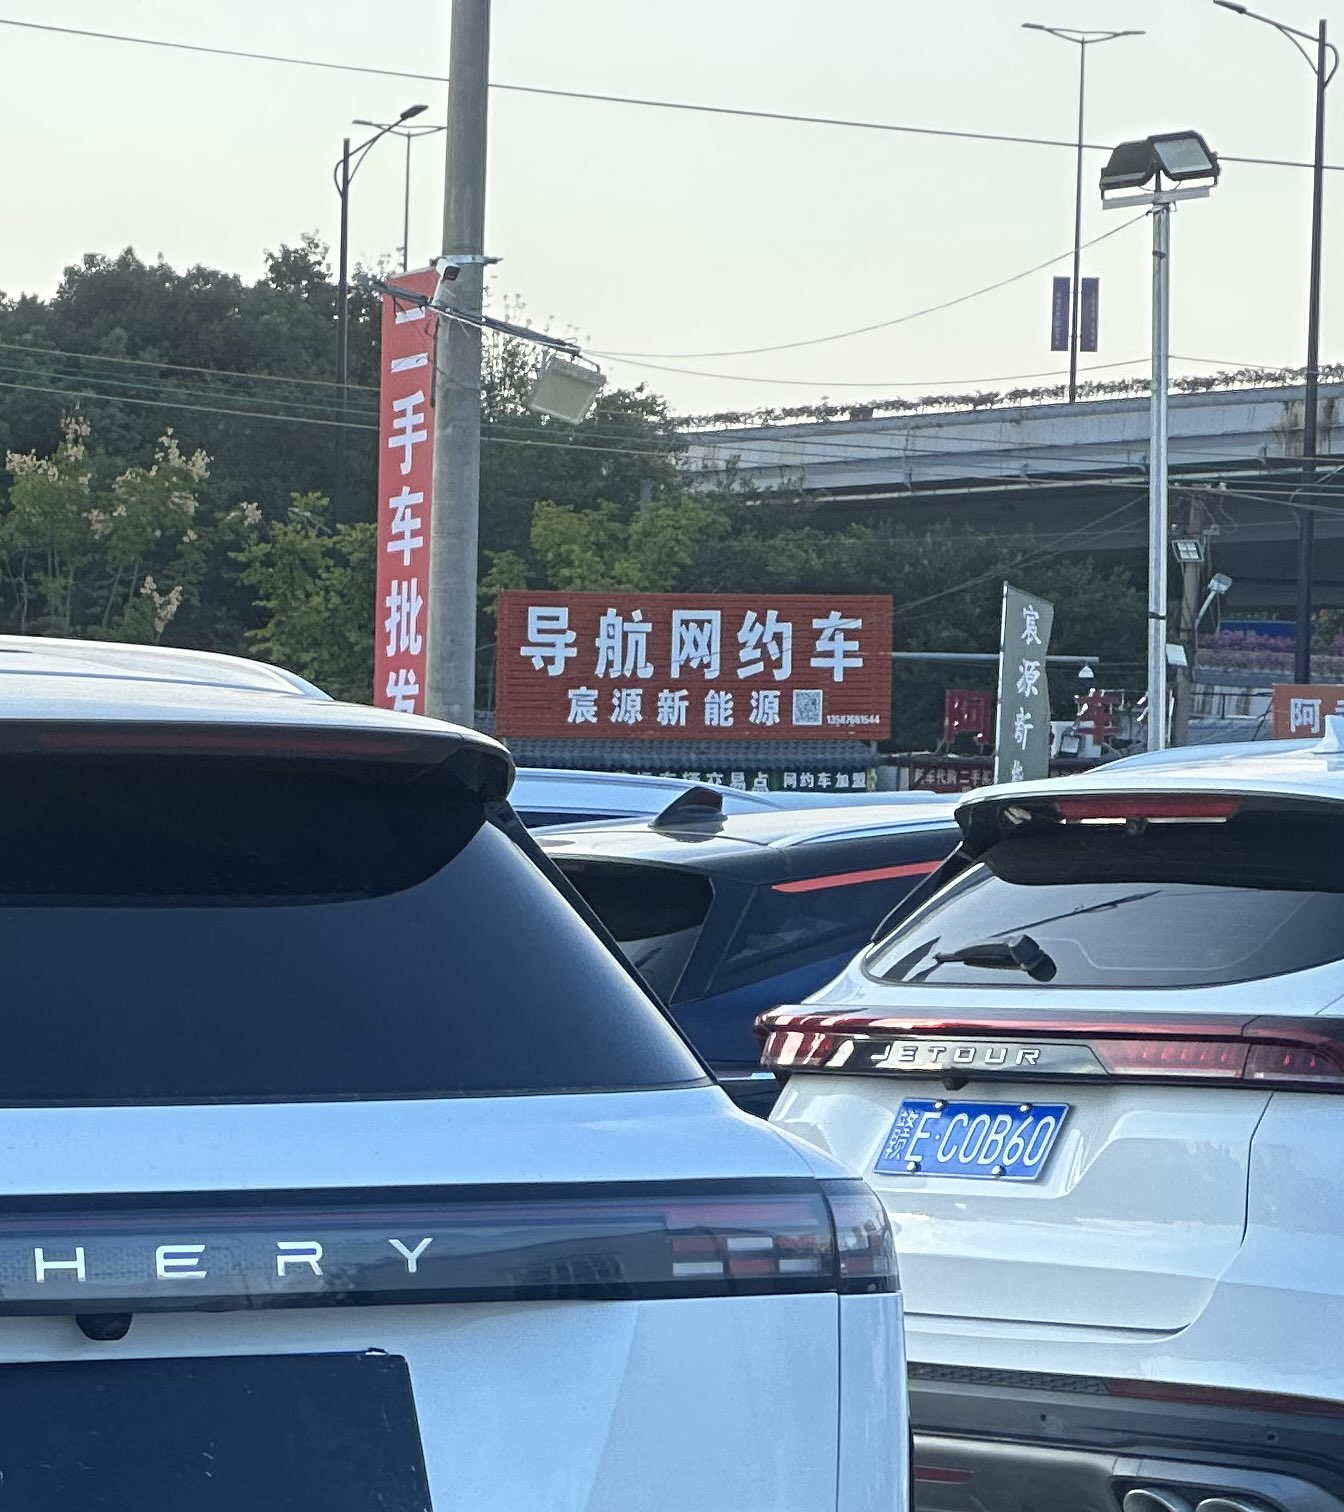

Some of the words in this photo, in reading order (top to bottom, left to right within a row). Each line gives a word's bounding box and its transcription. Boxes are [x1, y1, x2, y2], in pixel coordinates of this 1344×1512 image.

[384, 306, 429, 713] 二手车批发
[519, 606, 864, 682] 导航网约车
[566, 686, 782, 727] 宸源新能源
[870, 1044, 1040, 1065] JETOUR
